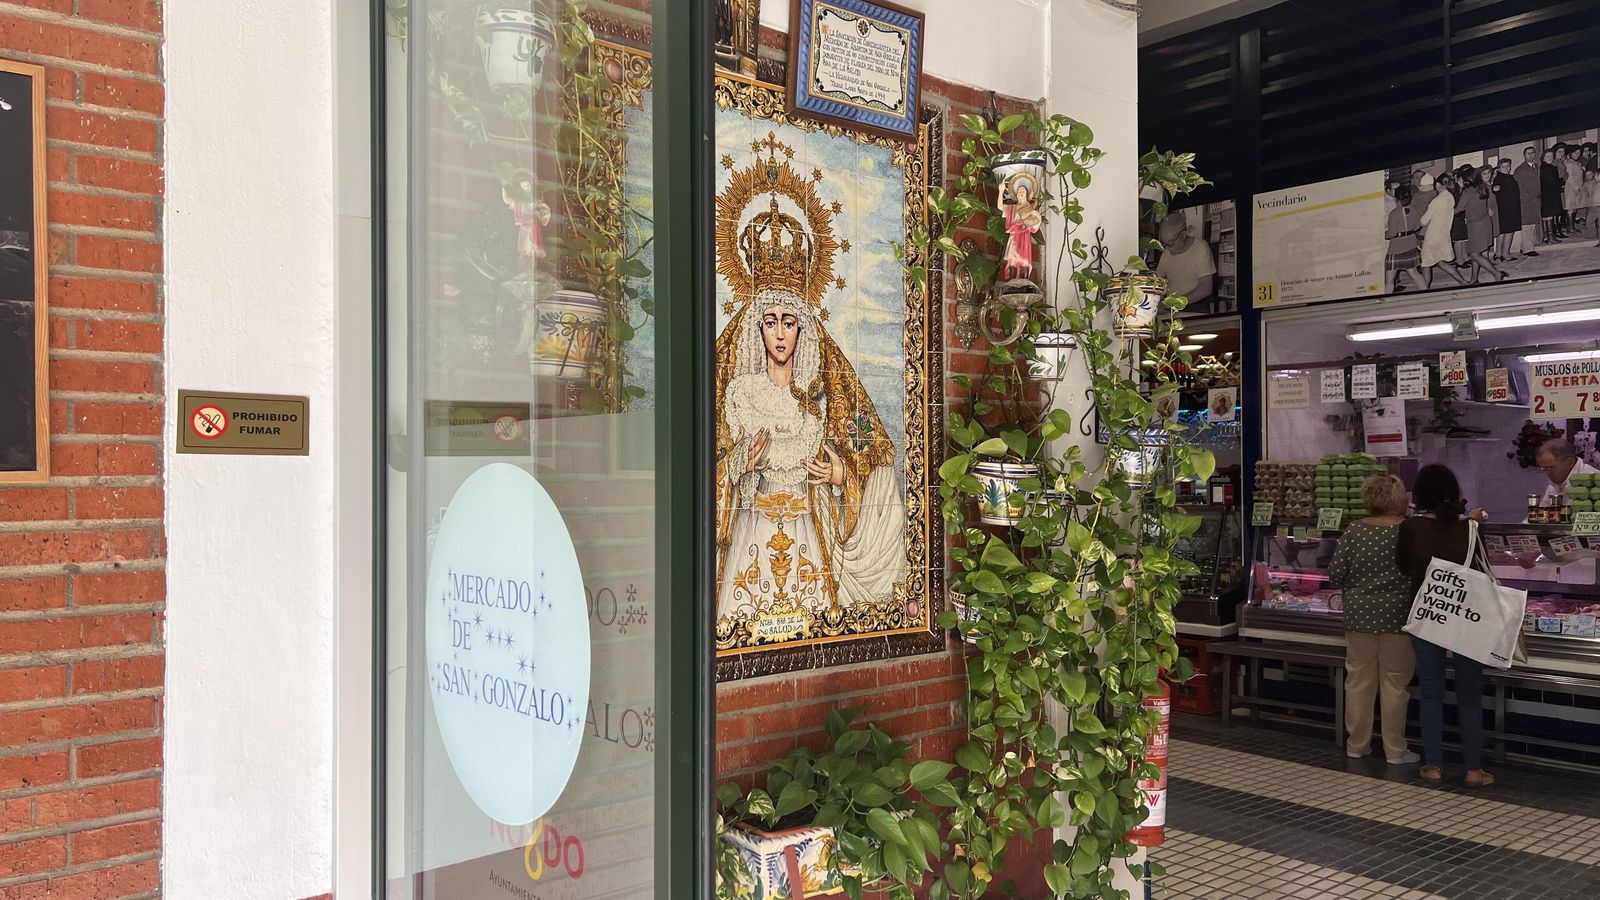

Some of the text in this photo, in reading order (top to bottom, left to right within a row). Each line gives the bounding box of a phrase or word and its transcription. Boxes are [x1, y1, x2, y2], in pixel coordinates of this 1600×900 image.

[1257, 194, 1306, 210] Vecindario
[1258, 285, 1272, 301] 31
[1535, 362, 1600, 376] MUSLOS de POLL
[1543, 375, 1599, 387] OFERTA
[1534, 395, 1545, 413] 2
[1577, 392, 1588, 411] 7
[232, 412, 297, 422] PROHIBIDO
[240, 426, 280, 435] FUMAR
[1431, 568, 1466, 588] Gifts
[453, 573, 531, 612] MERCADO
[1415, 607, 1447, 624] give
[1423, 595, 1481, 622] want to
[453, 620, 471, 650] DE
[769, 625, 792, 634] SALUD
[443, 663, 564, 725] SAN GONZALO
